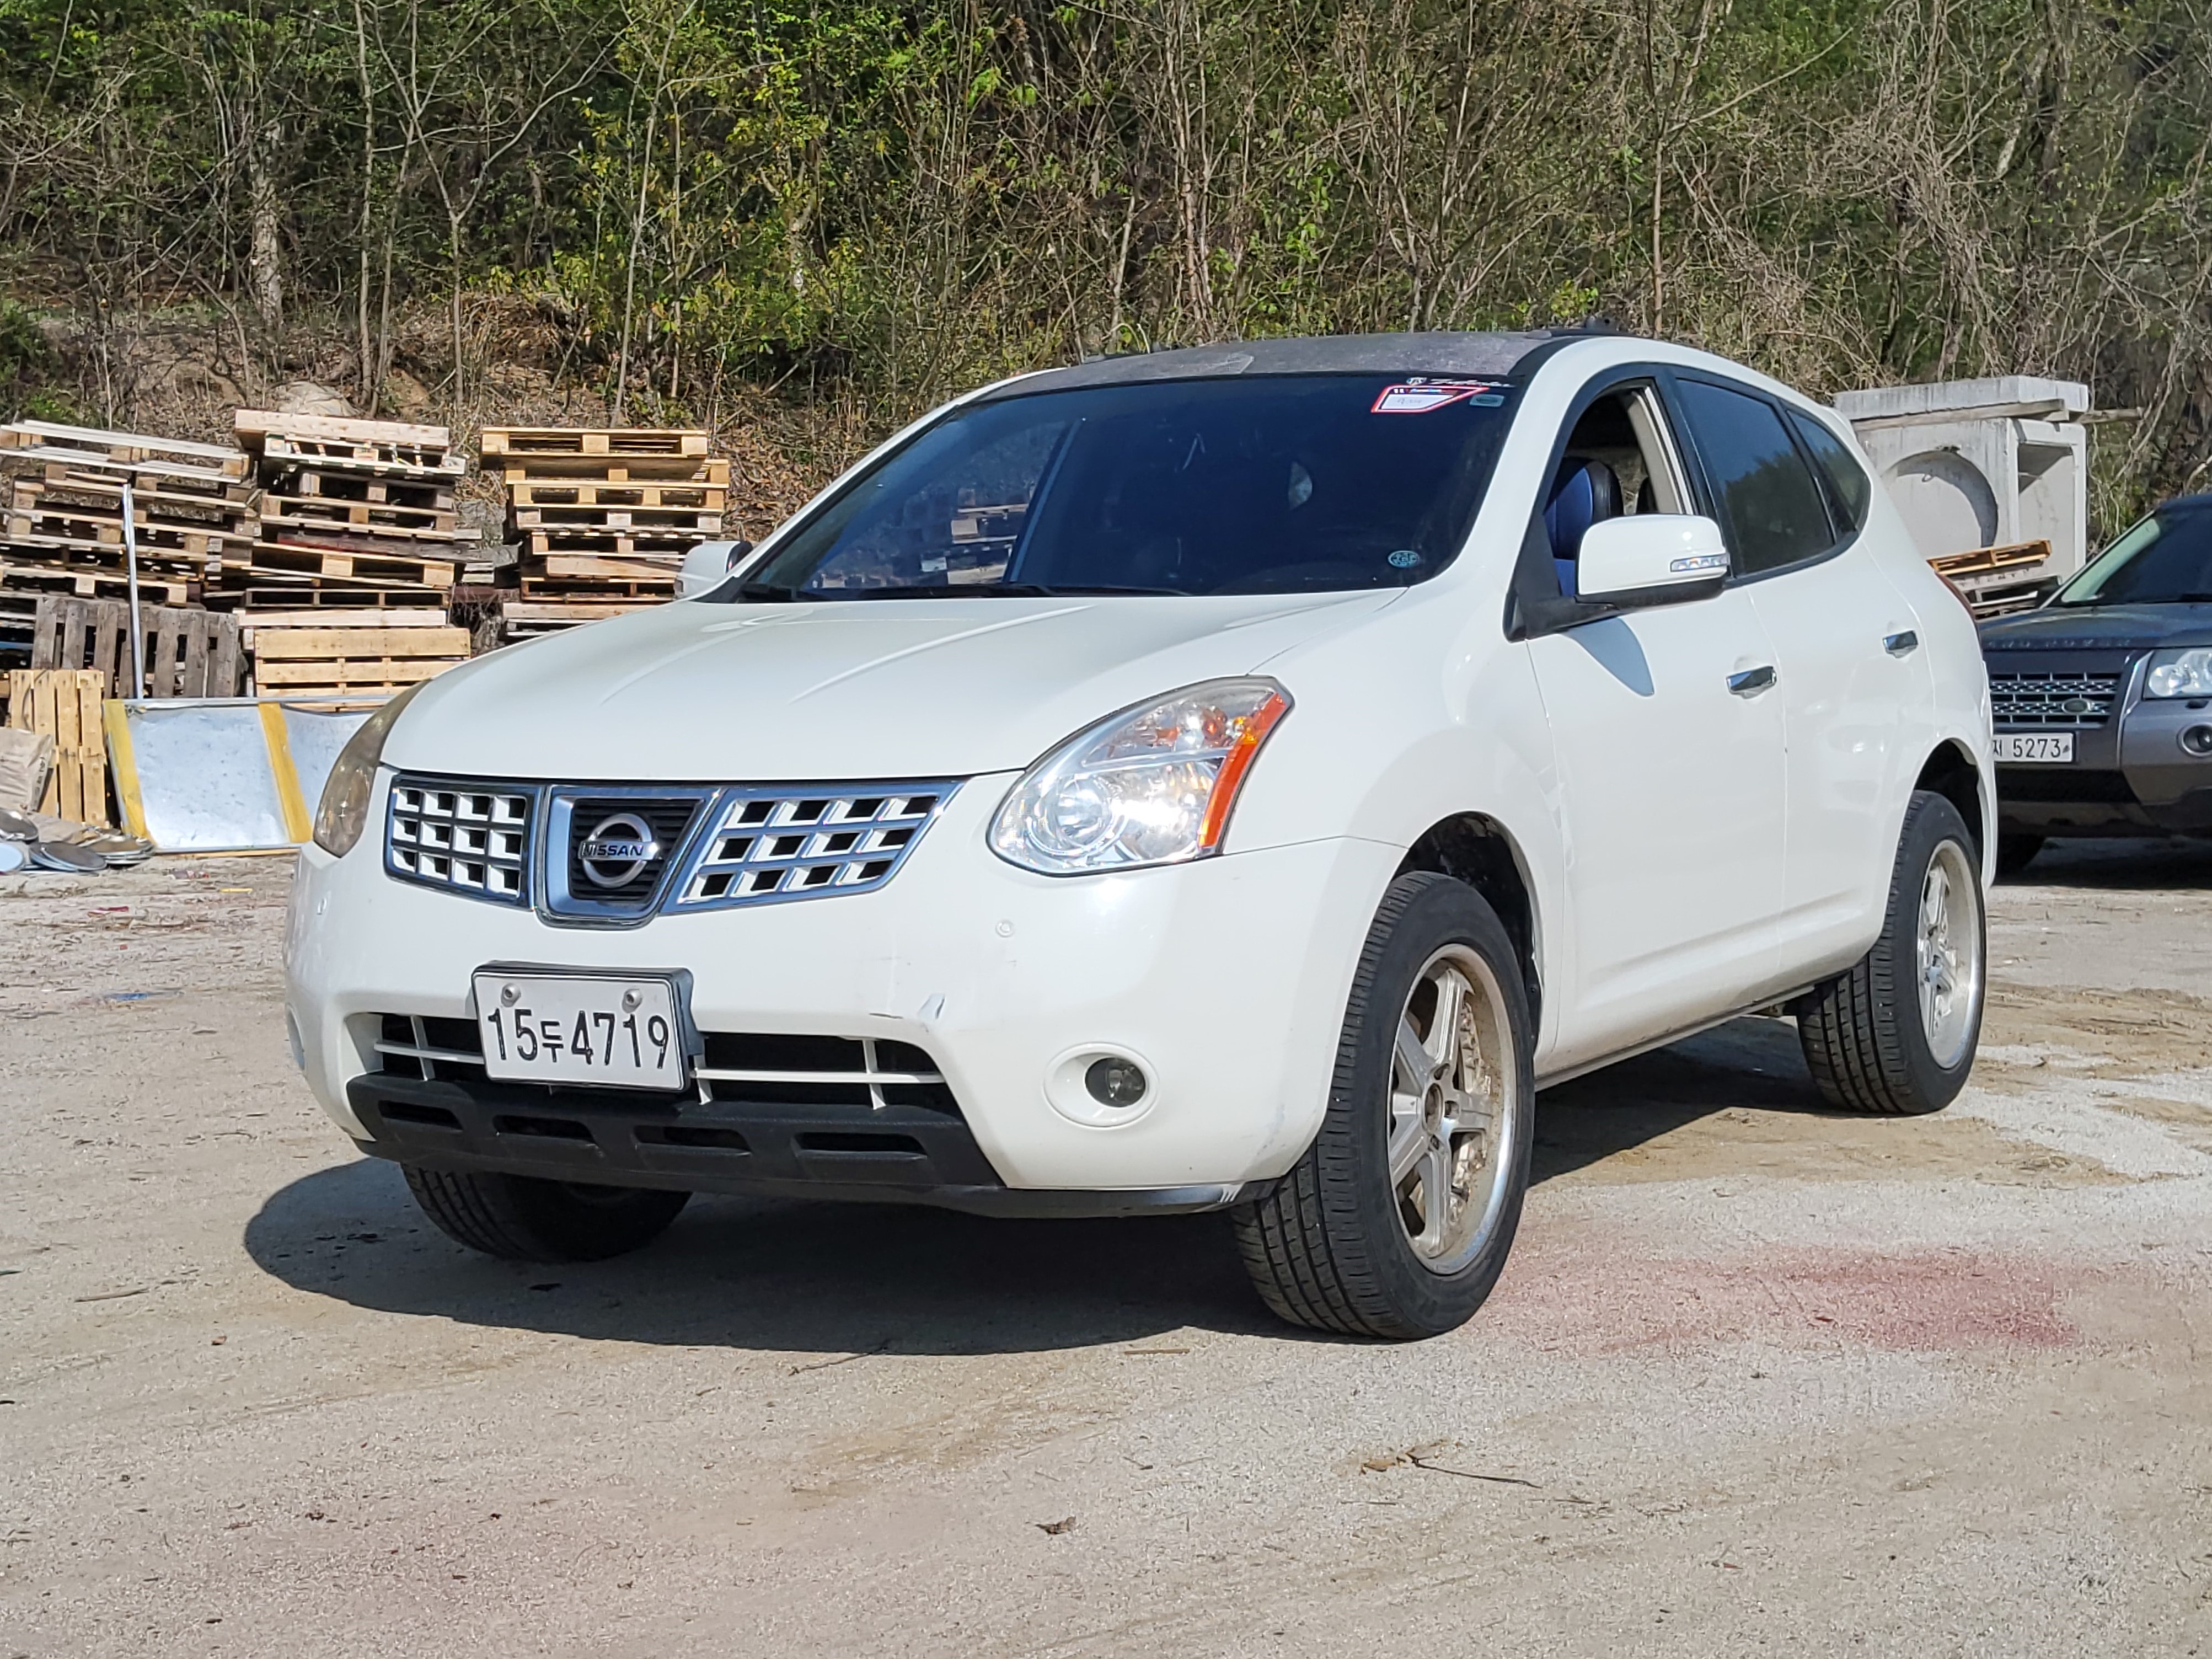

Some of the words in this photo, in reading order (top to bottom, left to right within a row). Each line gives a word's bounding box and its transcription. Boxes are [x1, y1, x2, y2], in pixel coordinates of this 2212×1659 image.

[2013, 738, 2061, 758] 5273
[582, 844, 644, 856] NISSAN
[488, 1008, 670, 1069] 15두4719
